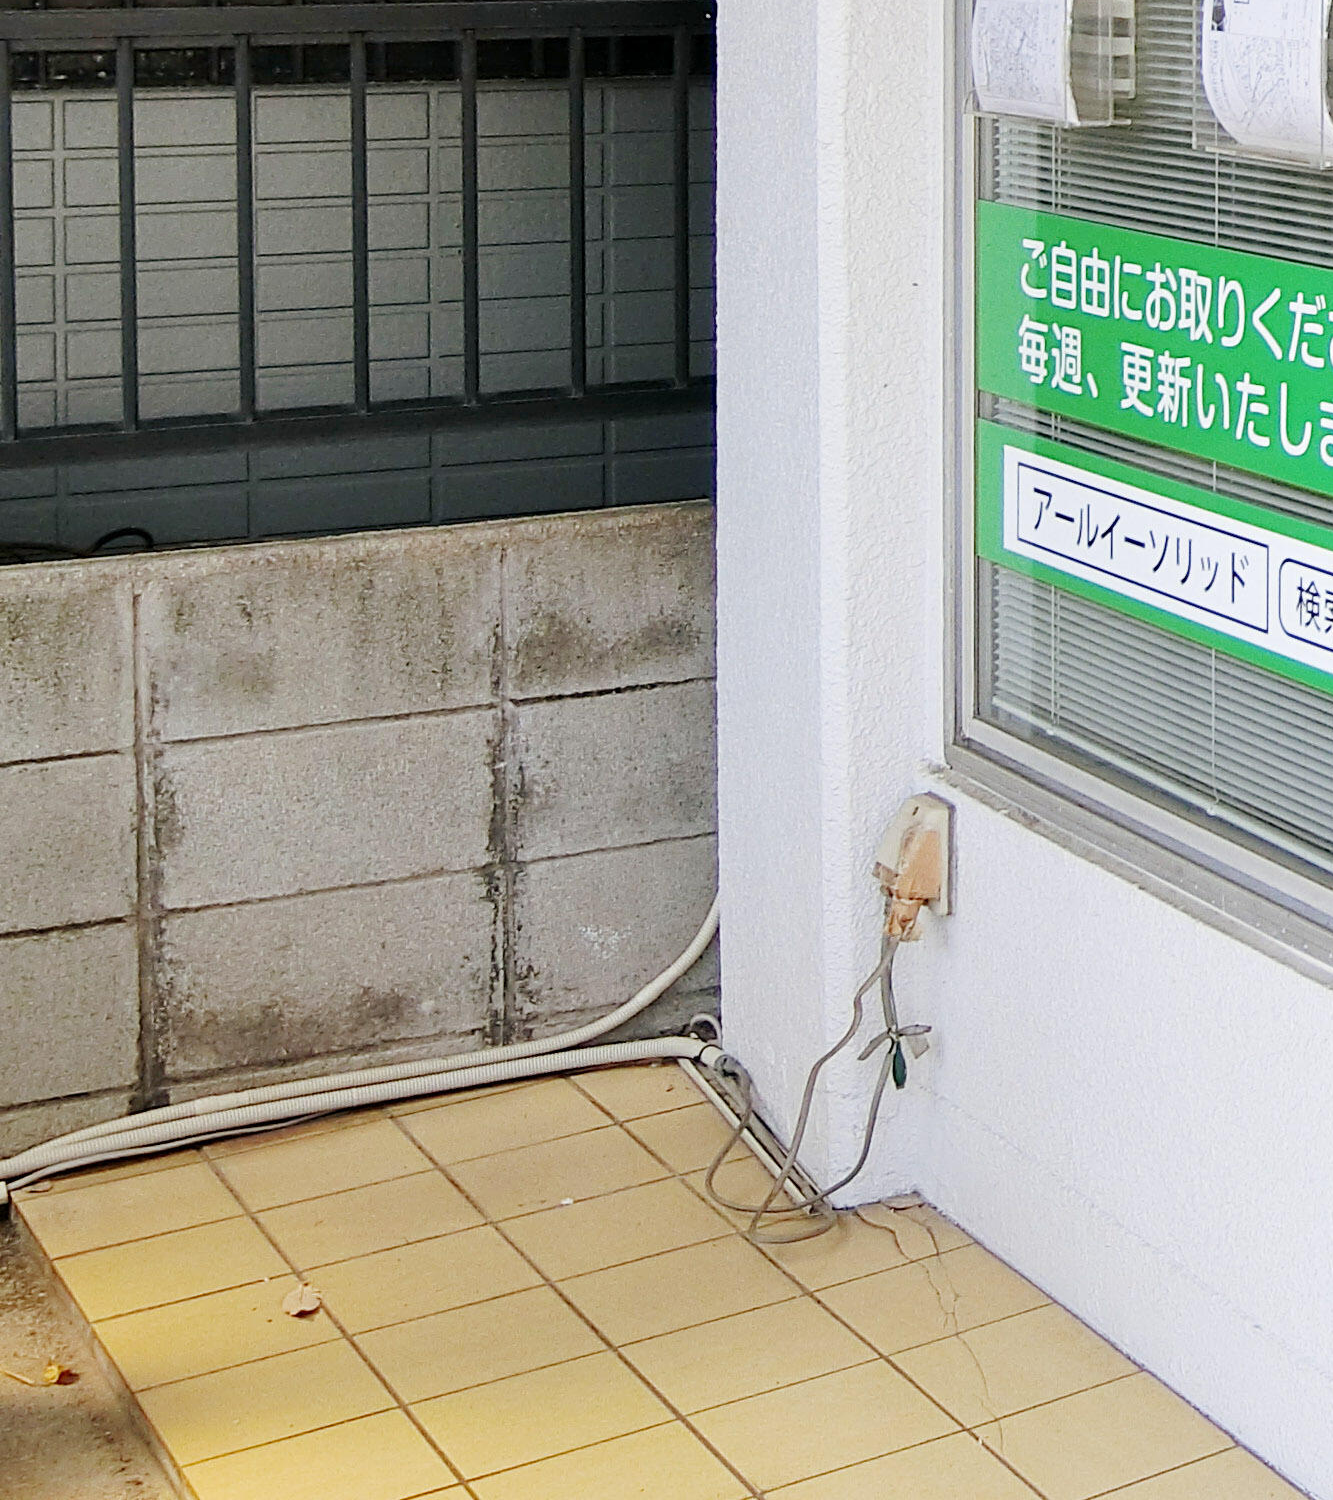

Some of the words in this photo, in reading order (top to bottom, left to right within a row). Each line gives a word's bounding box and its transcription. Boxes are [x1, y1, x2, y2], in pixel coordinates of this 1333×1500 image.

[1032, 487, 1249, 604] アールイーソリッド
